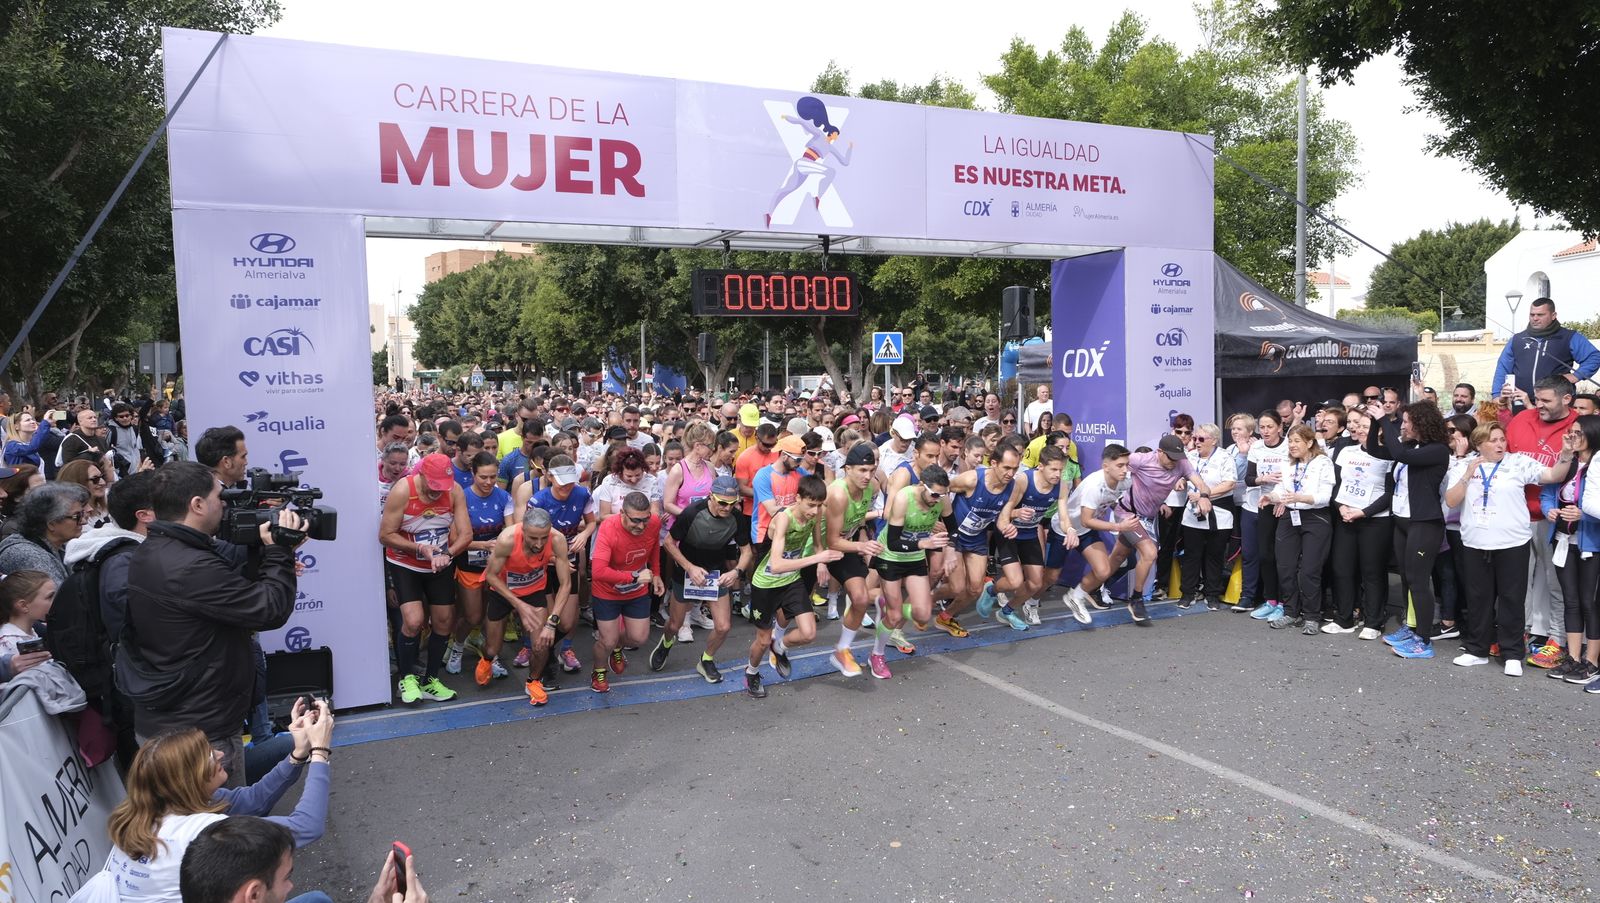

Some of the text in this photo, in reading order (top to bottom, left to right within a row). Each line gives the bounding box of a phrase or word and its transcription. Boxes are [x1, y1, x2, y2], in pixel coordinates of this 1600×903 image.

[393, 83, 630, 126] CARRERA DE LA
[984, 135, 1100, 163] LA IGUALDAD
[378, 121, 646, 197] MUJER
[954, 164, 1126, 194] ES NUESTRA META.
[963, 199, 993, 217] CDX
[1025, 202, 1058, 213] ALMERÍA
[233, 257, 314, 268] HYUNDAI
[244, 270, 306, 280] Almerialva
[1153, 279, 1191, 287] HYUNDAI
[724, 274, 851, 311] 00:00:00
[256, 295, 321, 310] cajamar
[1163, 304, 1194, 315] cajamar
[243, 336, 300, 356] CASI
[1155, 333, 1183, 346] CASI
[1062, 344, 1108, 378] CDX
[1164, 356, 1192, 367] vithas
[265, 371, 324, 386] vithas
[1159, 387, 1192, 400] aqualia
[257, 416, 326, 435] aqualia
[1075, 421, 1117, 435] ALMERÍA
[1074, 434, 1096, 443] CIUDAD
[1345, 485, 1366, 497] 1359
